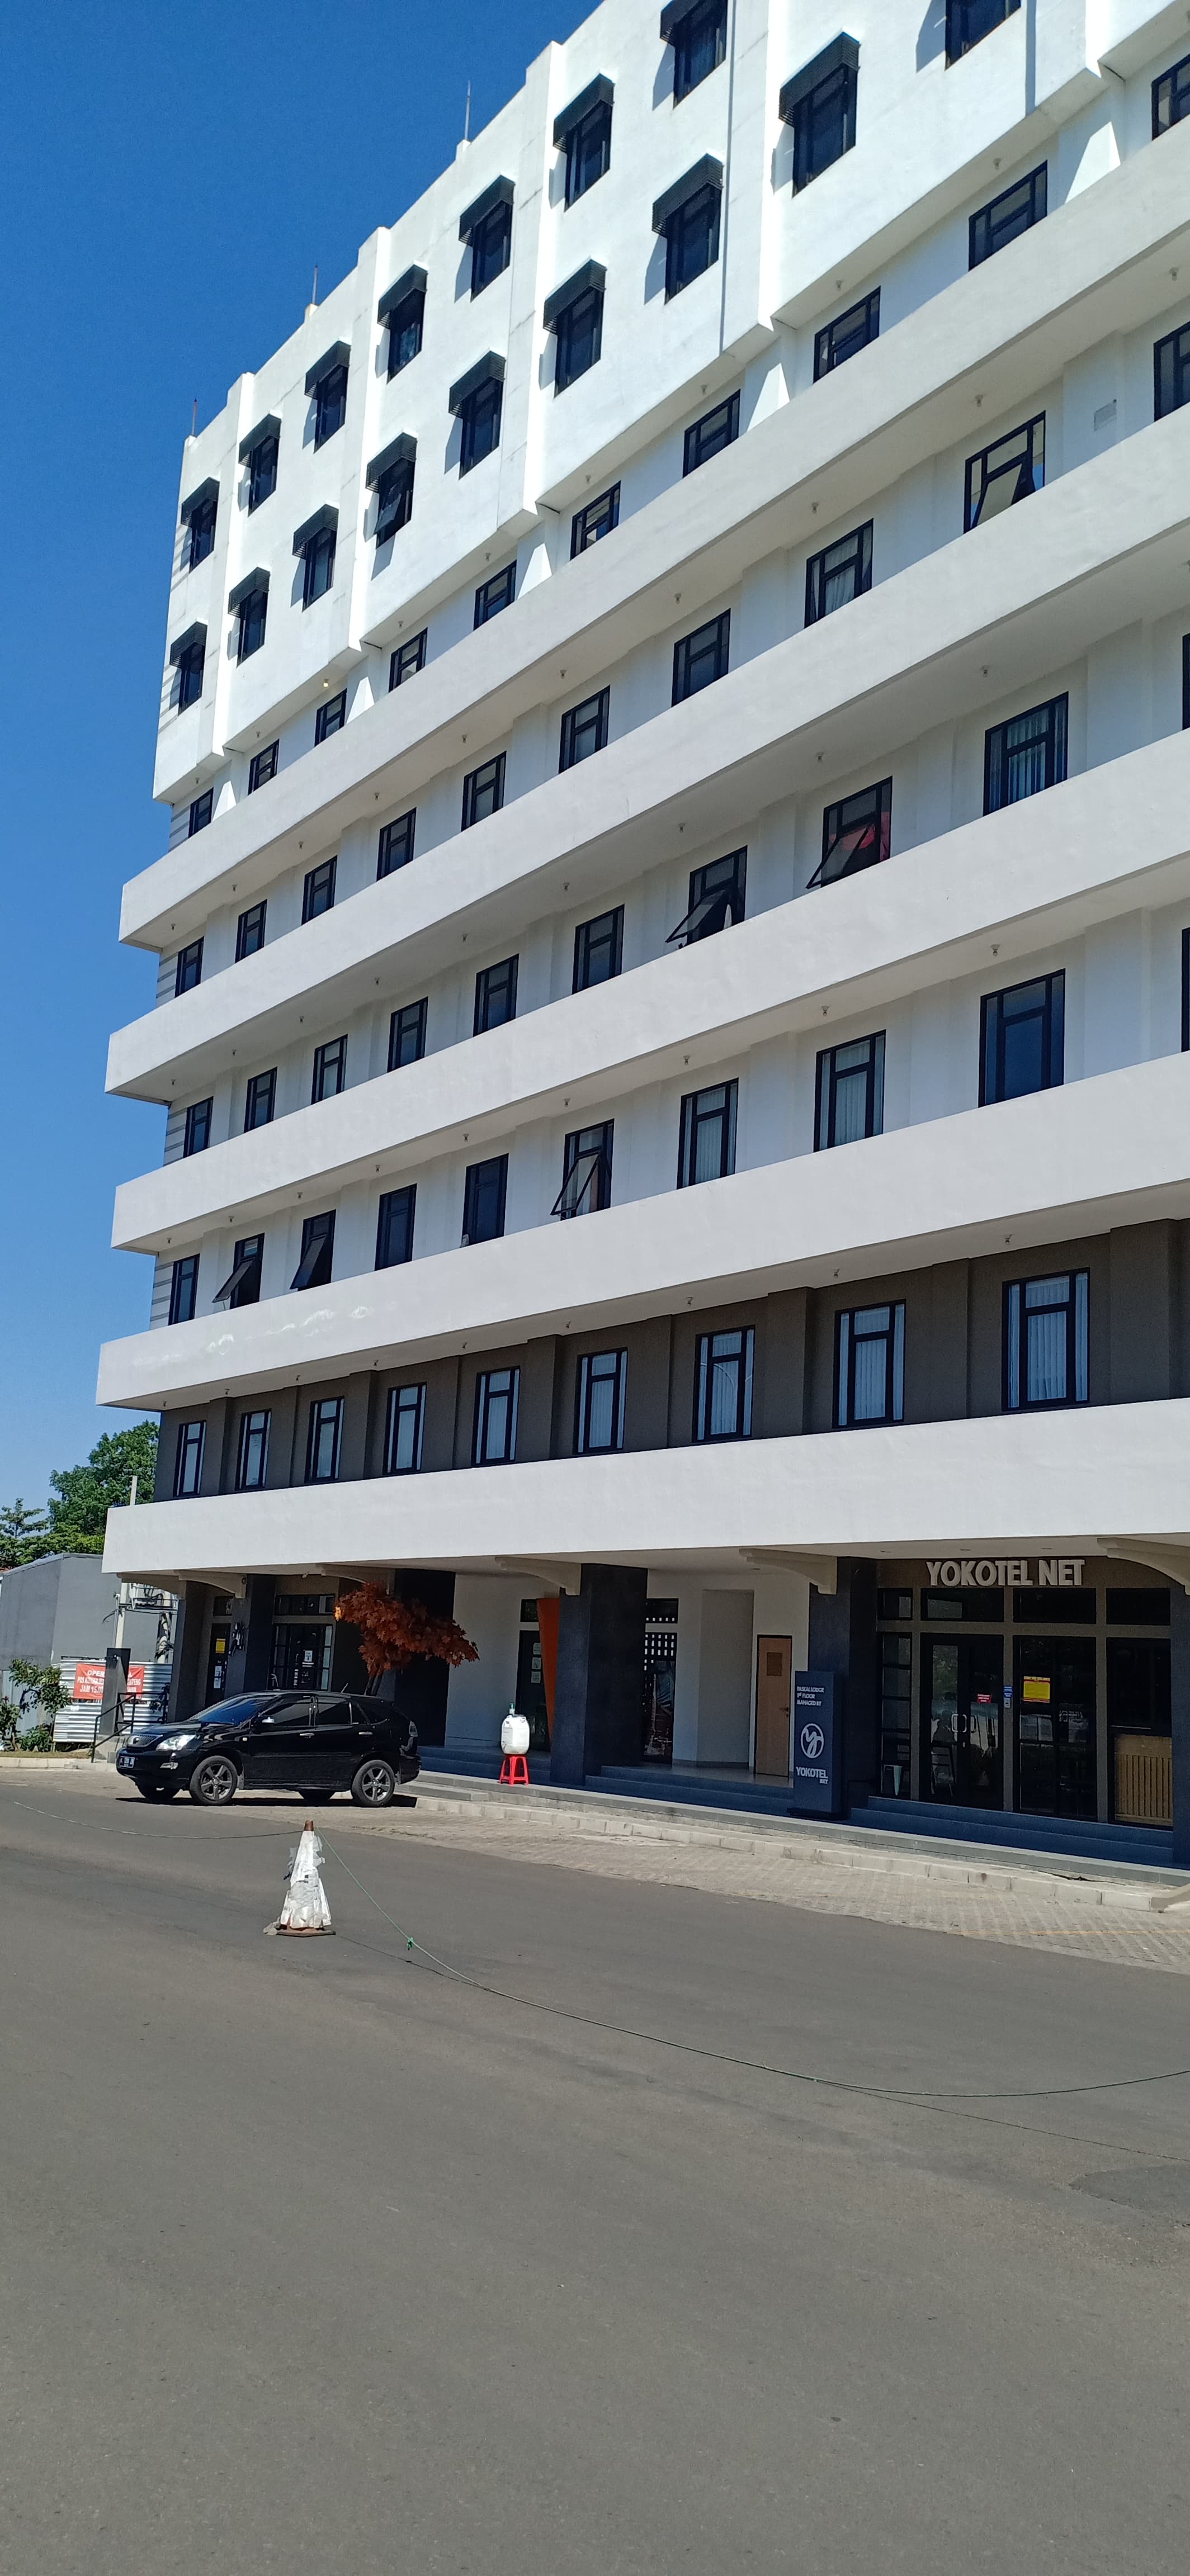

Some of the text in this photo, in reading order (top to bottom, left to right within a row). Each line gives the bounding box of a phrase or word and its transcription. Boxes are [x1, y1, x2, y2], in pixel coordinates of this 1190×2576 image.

[926, 1559, 1085, 1587] YOKOTEL NET
[796, 1767, 828, 1778] YOKOTEL
